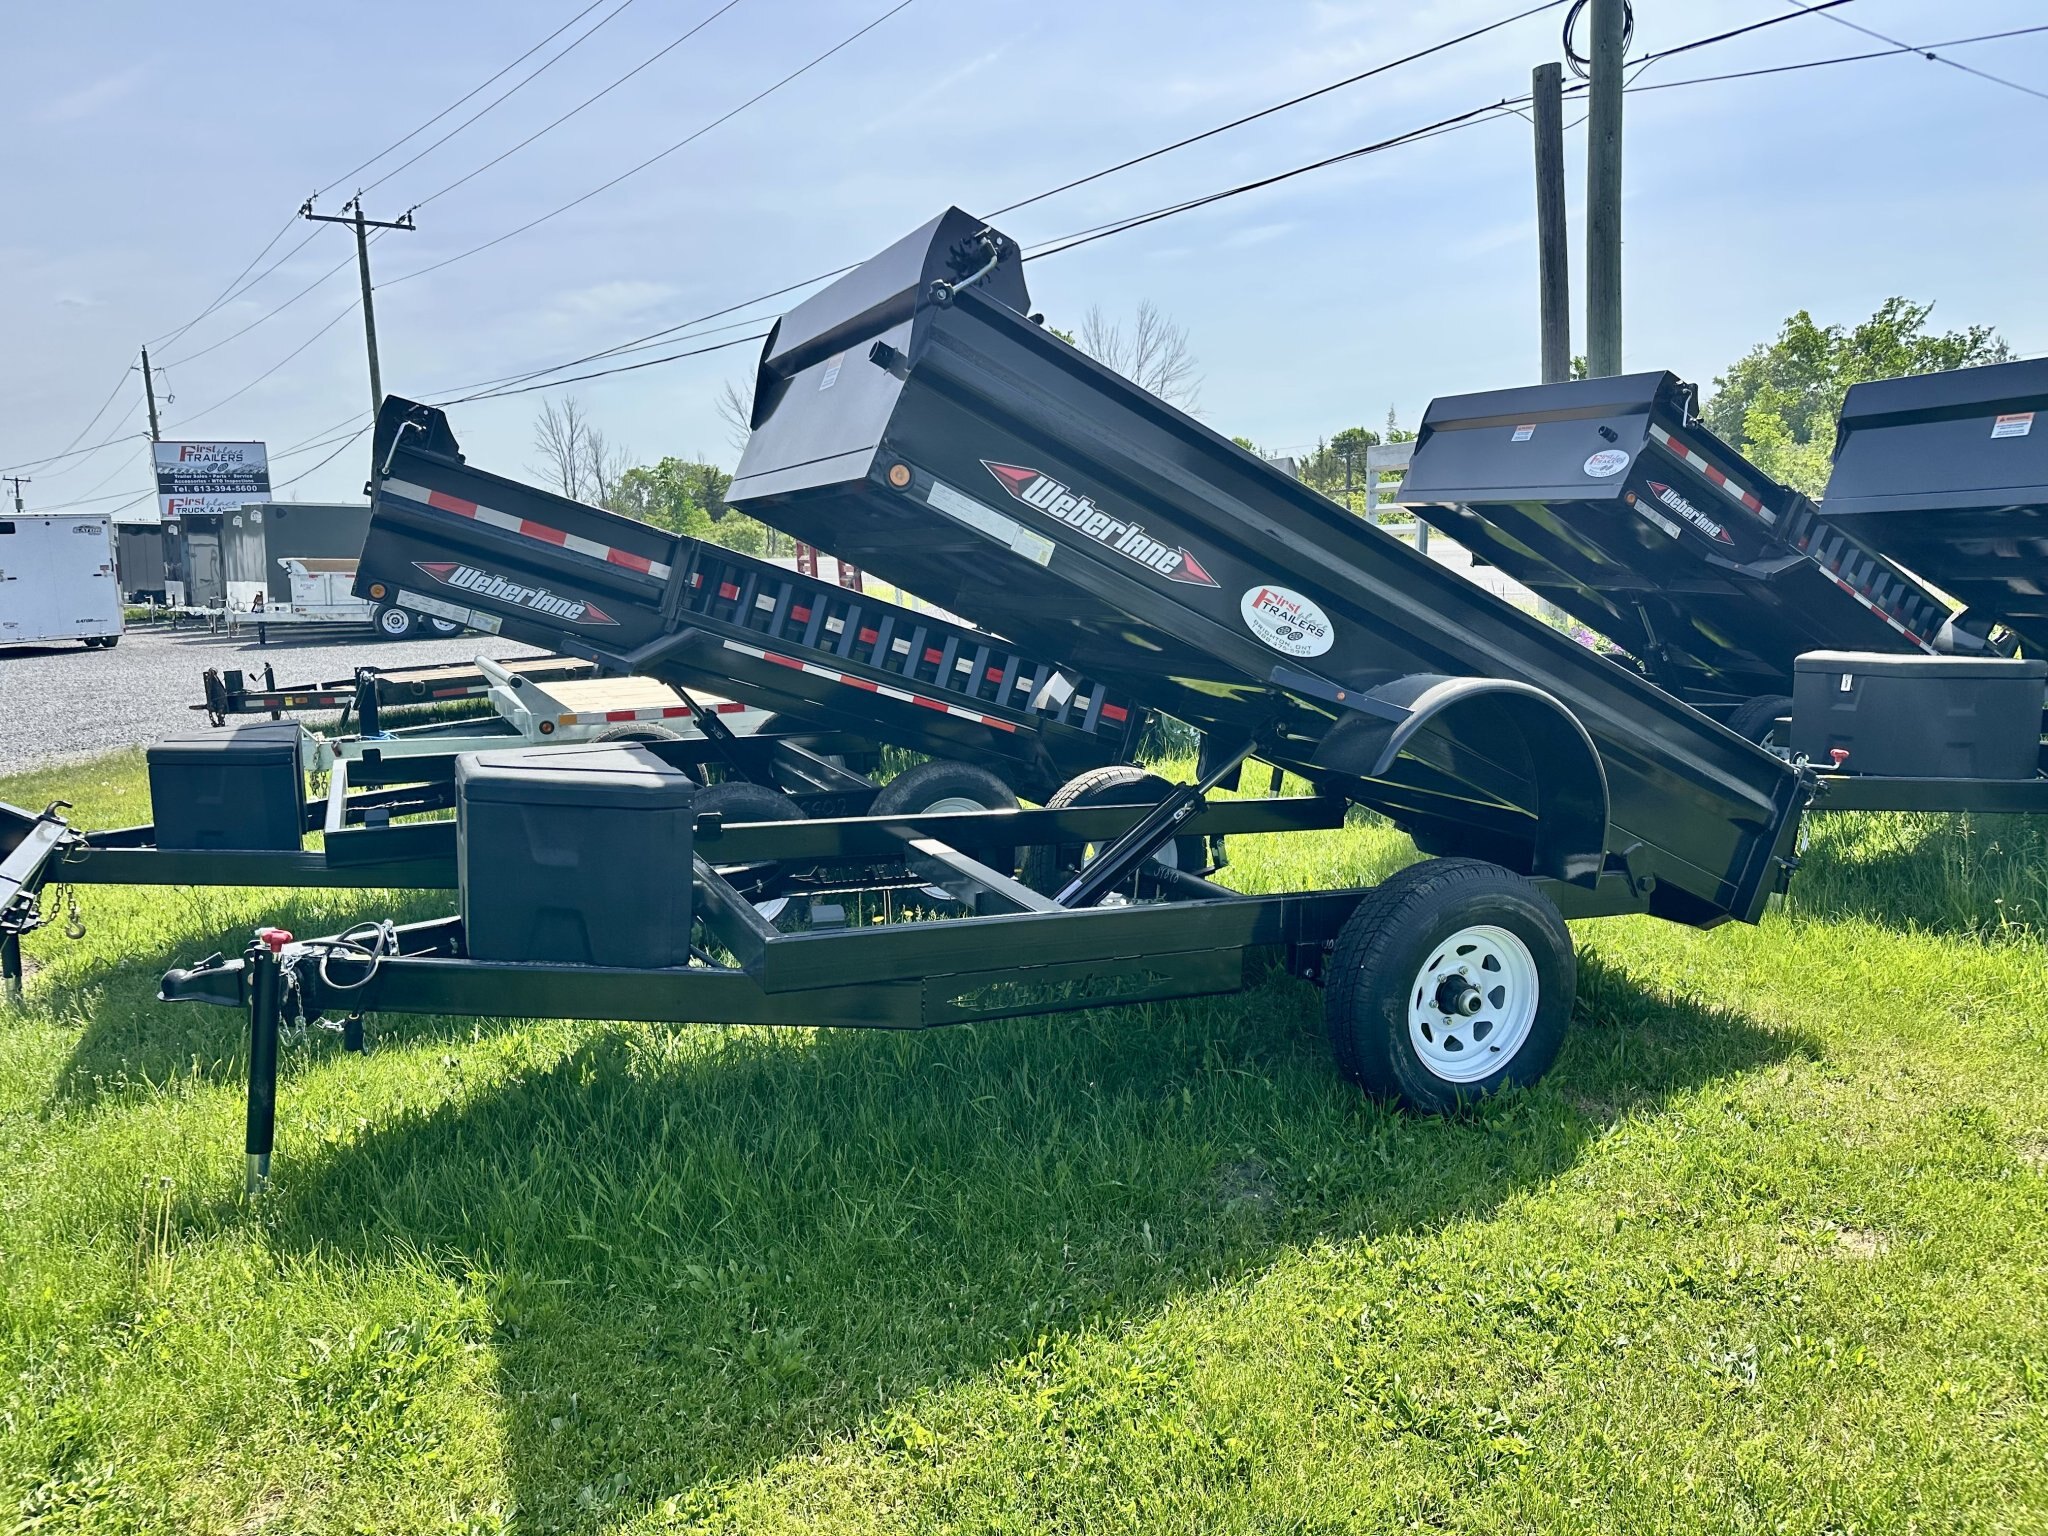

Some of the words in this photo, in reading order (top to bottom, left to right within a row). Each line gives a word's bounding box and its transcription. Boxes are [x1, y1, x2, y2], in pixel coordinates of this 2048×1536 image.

[179, 445, 216, 462] First
[217, 446, 243, 457] place
[187, 454, 243, 462] TRAILERS
[168, 497, 205, 515] First
[206, 497, 237, 509] place
[1660, 488, 1721, 537] Weberlane
[1021, 475, 1184, 575] Weberlane
[447, 566, 586, 620] Weberlane
[1252, 588, 1301, 615] First
[1297, 612, 1329, 631] place
[1261, 601, 1326, 638] TRAILERS
[1173, 802, 1191, 820] GX
